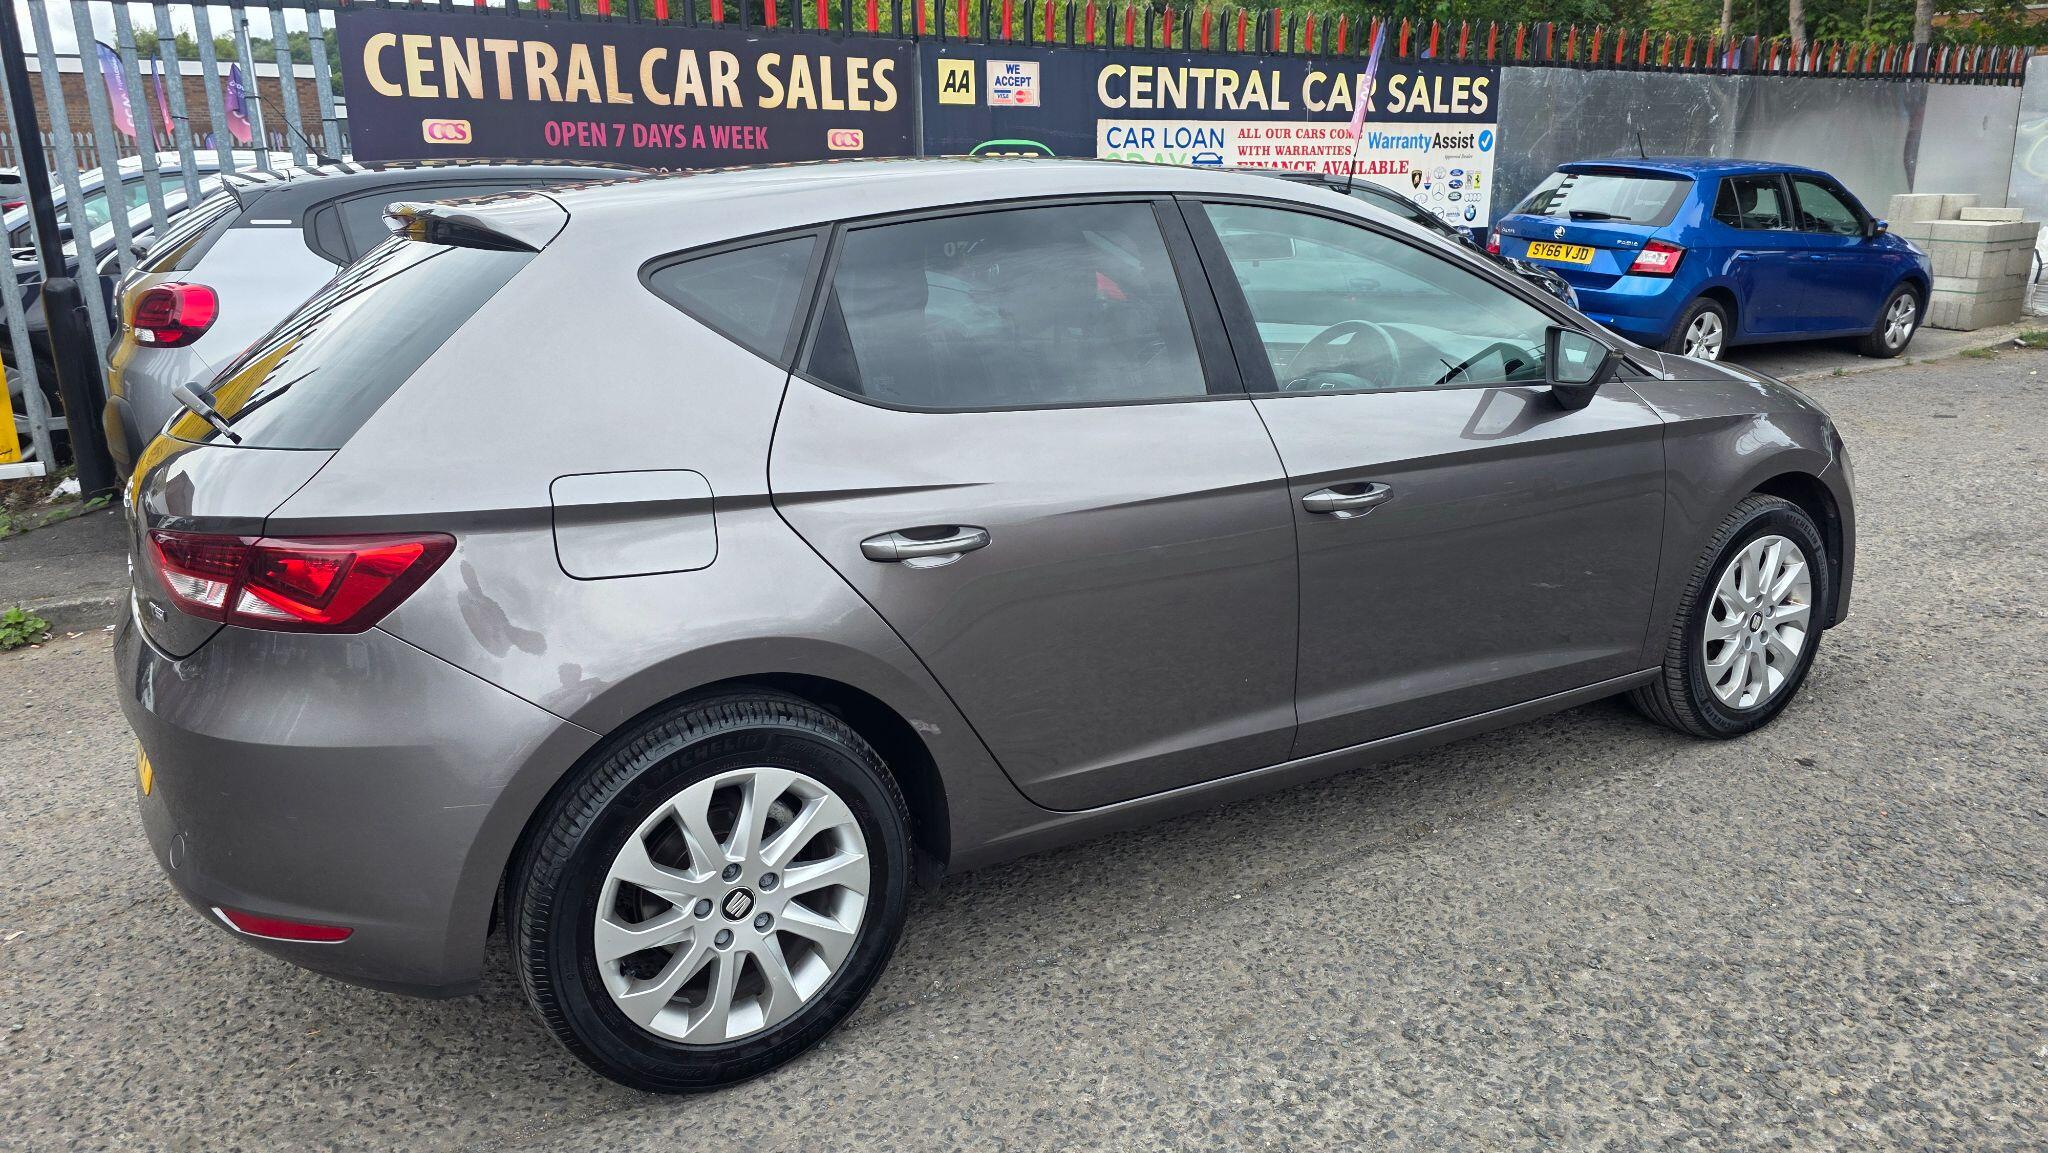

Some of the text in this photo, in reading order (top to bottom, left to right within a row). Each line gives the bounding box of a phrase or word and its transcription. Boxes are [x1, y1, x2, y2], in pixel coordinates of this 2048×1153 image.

[363, 32, 898, 112] CENTRAL CAR SALES
[1006, 64, 1021, 75] WE
[943, 69, 970, 94] AA
[994, 76, 1032, 87] ACCEPT
[1097, 64, 1290, 111] CENTRAL
[1302, 71, 1377, 112] CAR
[1386, 73, 1490, 115] SALES
[544, 120, 769, 150] OPEN 7 DAYS A WEEK
[1106, 126, 1224, 149] CAR LOAN
[1237, 128, 1363, 140] ALL OUR CARS COM
[1237, 145, 1352, 156] WITH WARRANTIES
[1322, 160, 1409, 175] AVAILABLE
[1532, 243, 1588, 260] SY66 VJD
